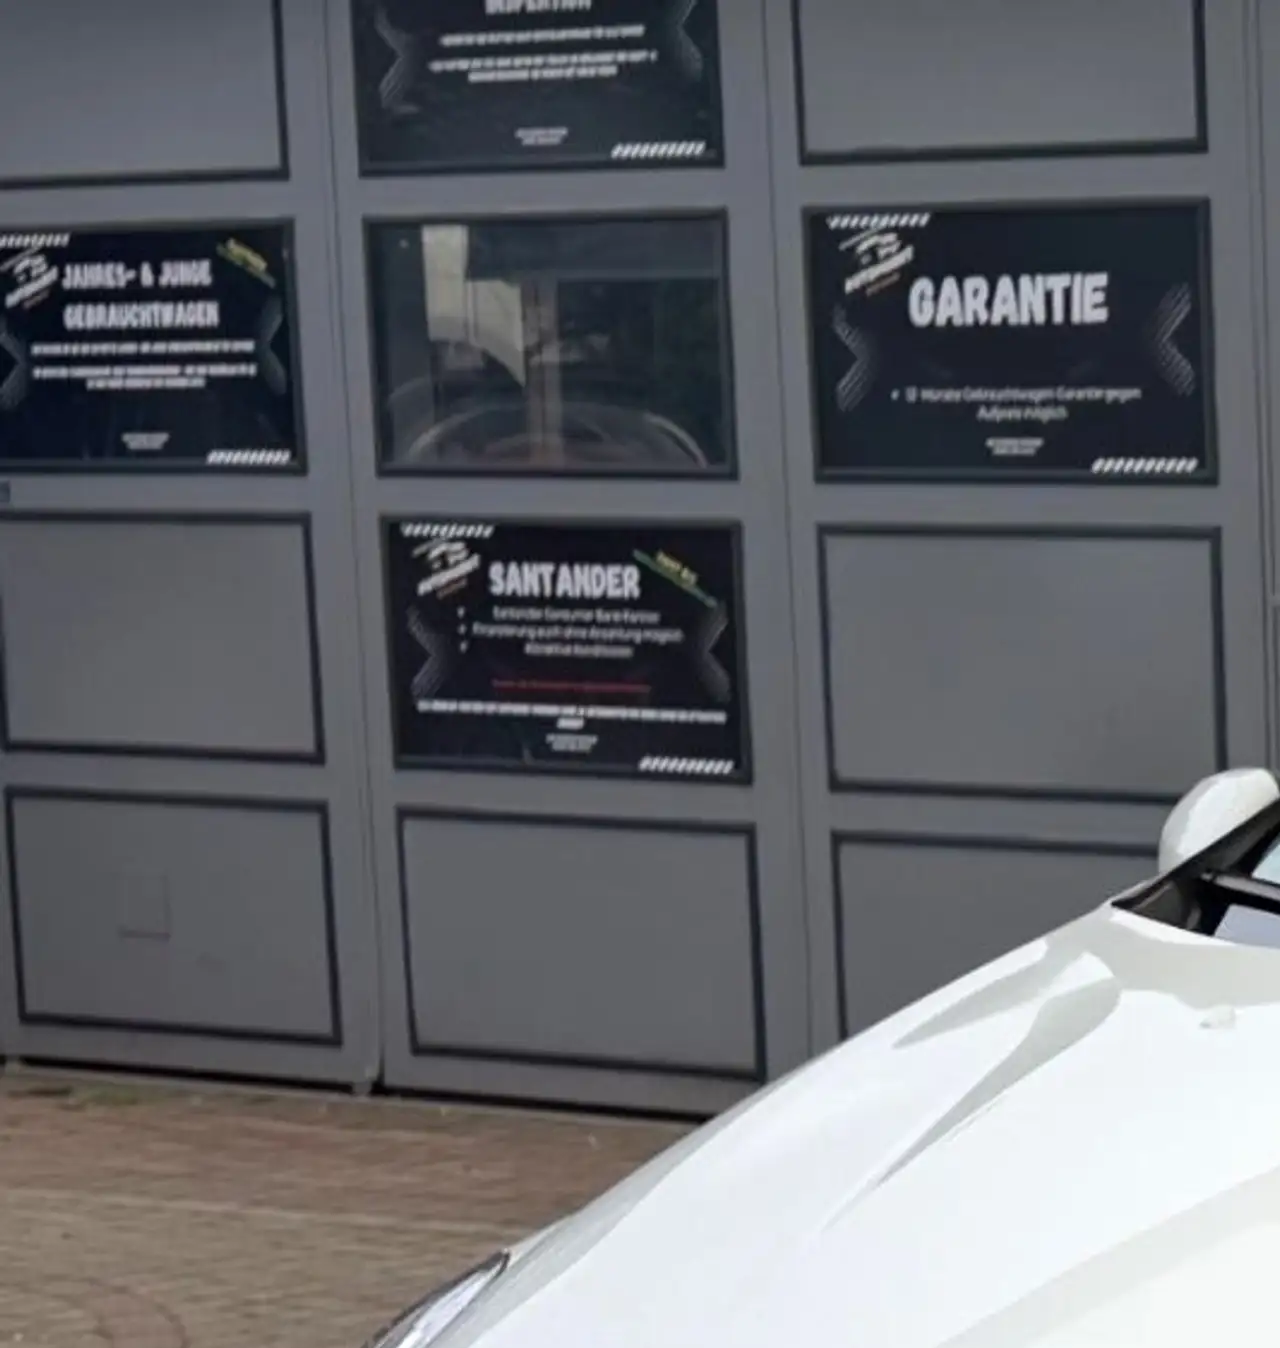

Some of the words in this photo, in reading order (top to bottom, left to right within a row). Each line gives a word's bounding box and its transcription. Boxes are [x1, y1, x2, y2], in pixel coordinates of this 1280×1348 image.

[62, 263, 136, 289] JAHRES-
[158, 259, 212, 287] JUNGE
[63, 301, 219, 330] GEBRAUCHTWAGEN
[908, 271, 1109, 328] GARANTIE
[489, 561, 640, 599] SANTANDER
